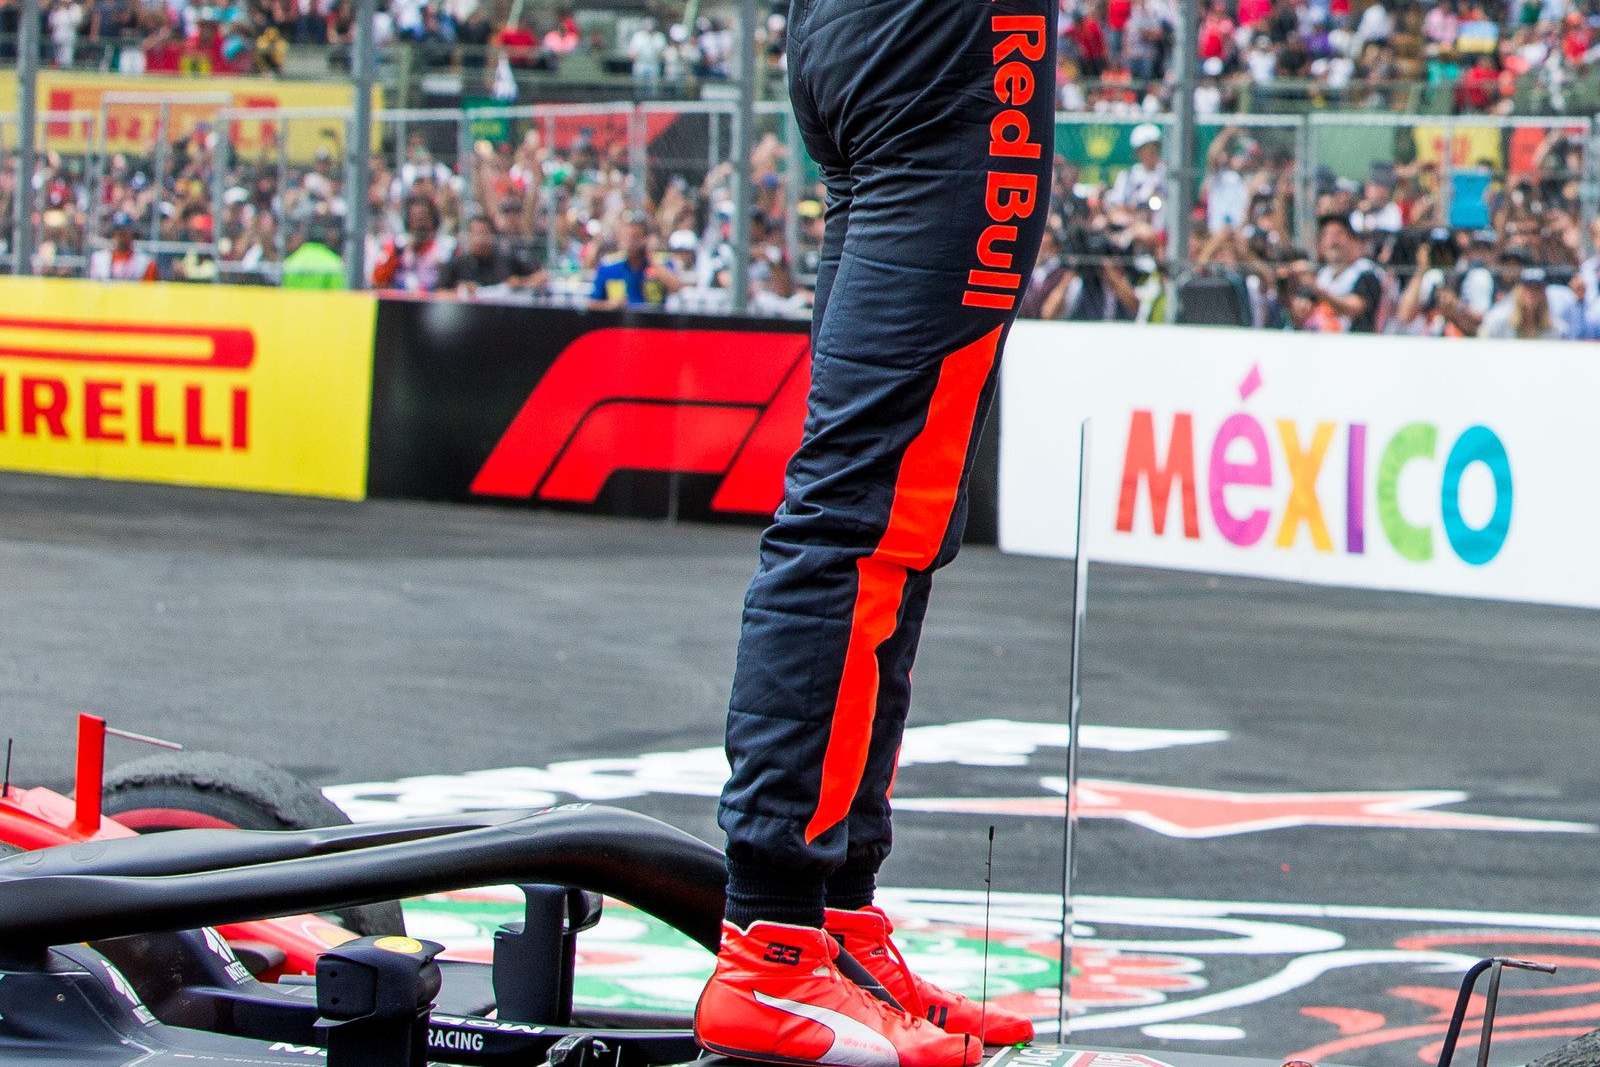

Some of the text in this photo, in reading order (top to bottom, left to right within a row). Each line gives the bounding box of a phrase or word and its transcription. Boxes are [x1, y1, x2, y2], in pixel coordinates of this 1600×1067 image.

[961, 15, 1046, 310] Red Bull
[763, 943, 803, 966] 33
[428, 1030, 484, 1051] RACING
